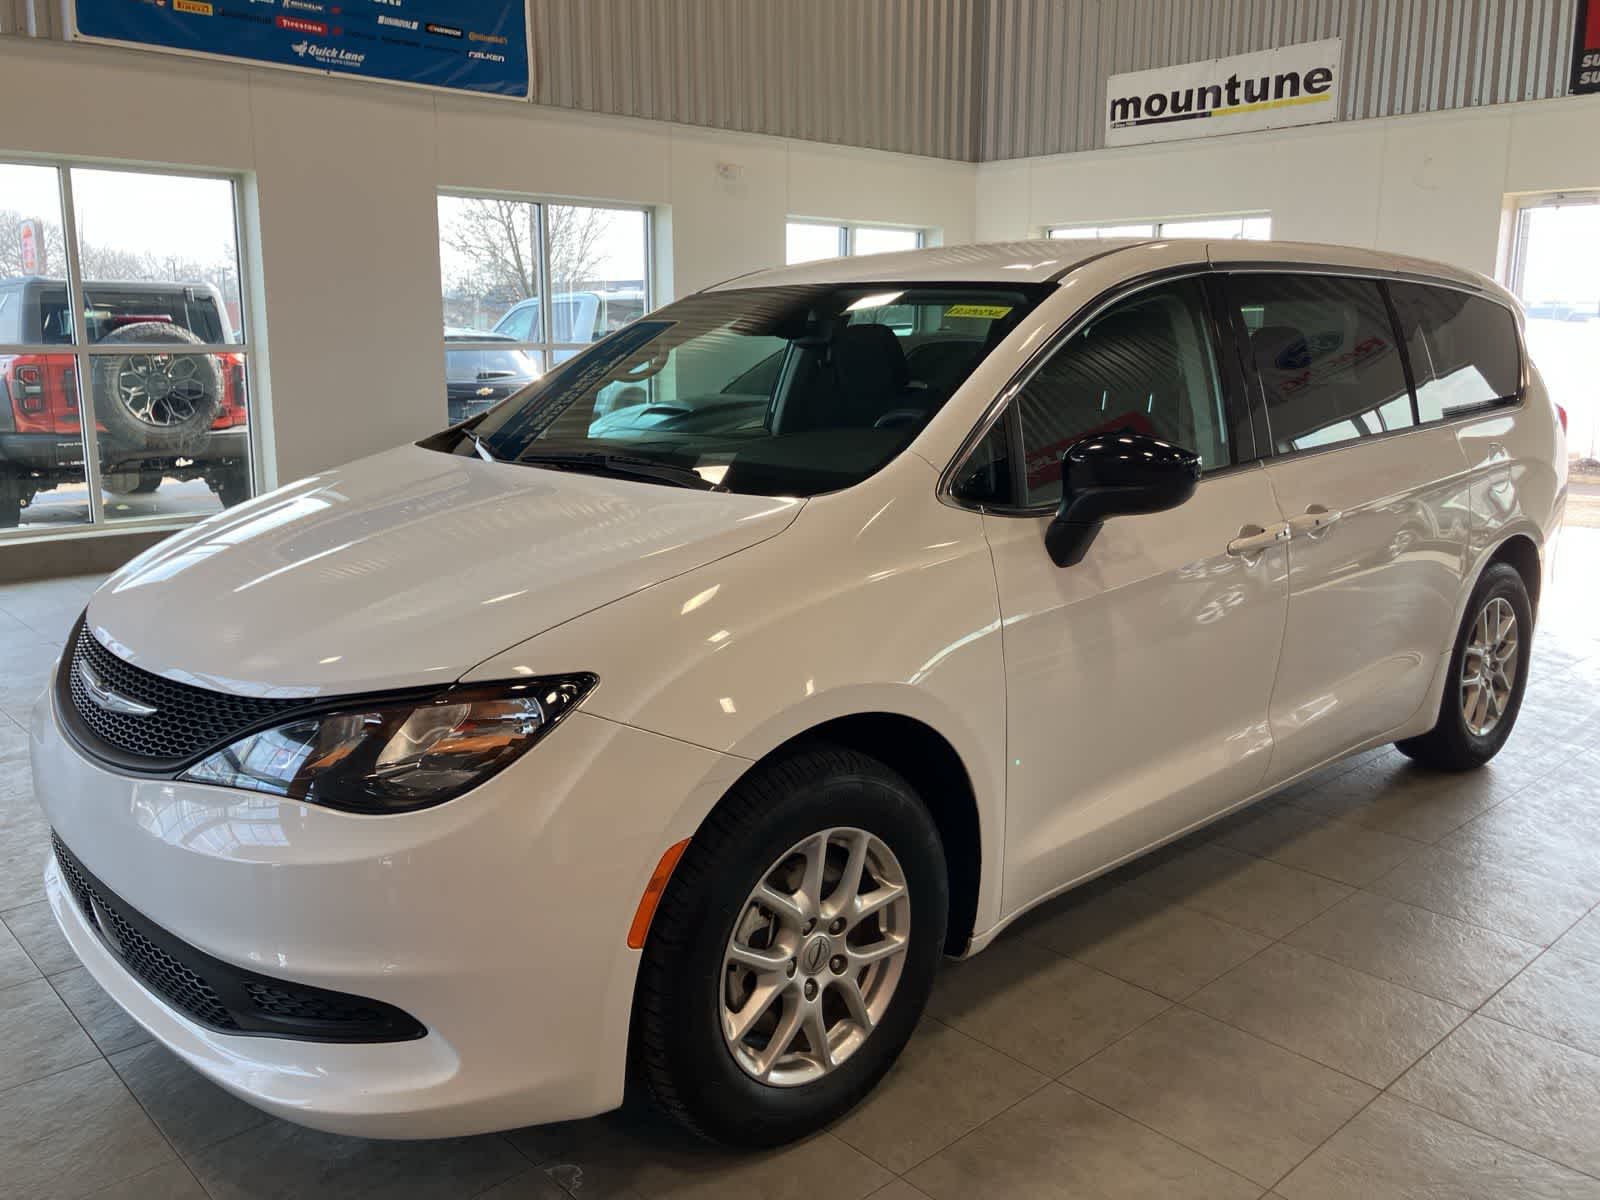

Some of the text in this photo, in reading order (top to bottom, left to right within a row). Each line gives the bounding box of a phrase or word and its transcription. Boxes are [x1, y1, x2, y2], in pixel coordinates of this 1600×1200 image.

[308, 45, 365, 62] Quick Lane
[1110, 67, 1333, 121] mountune
